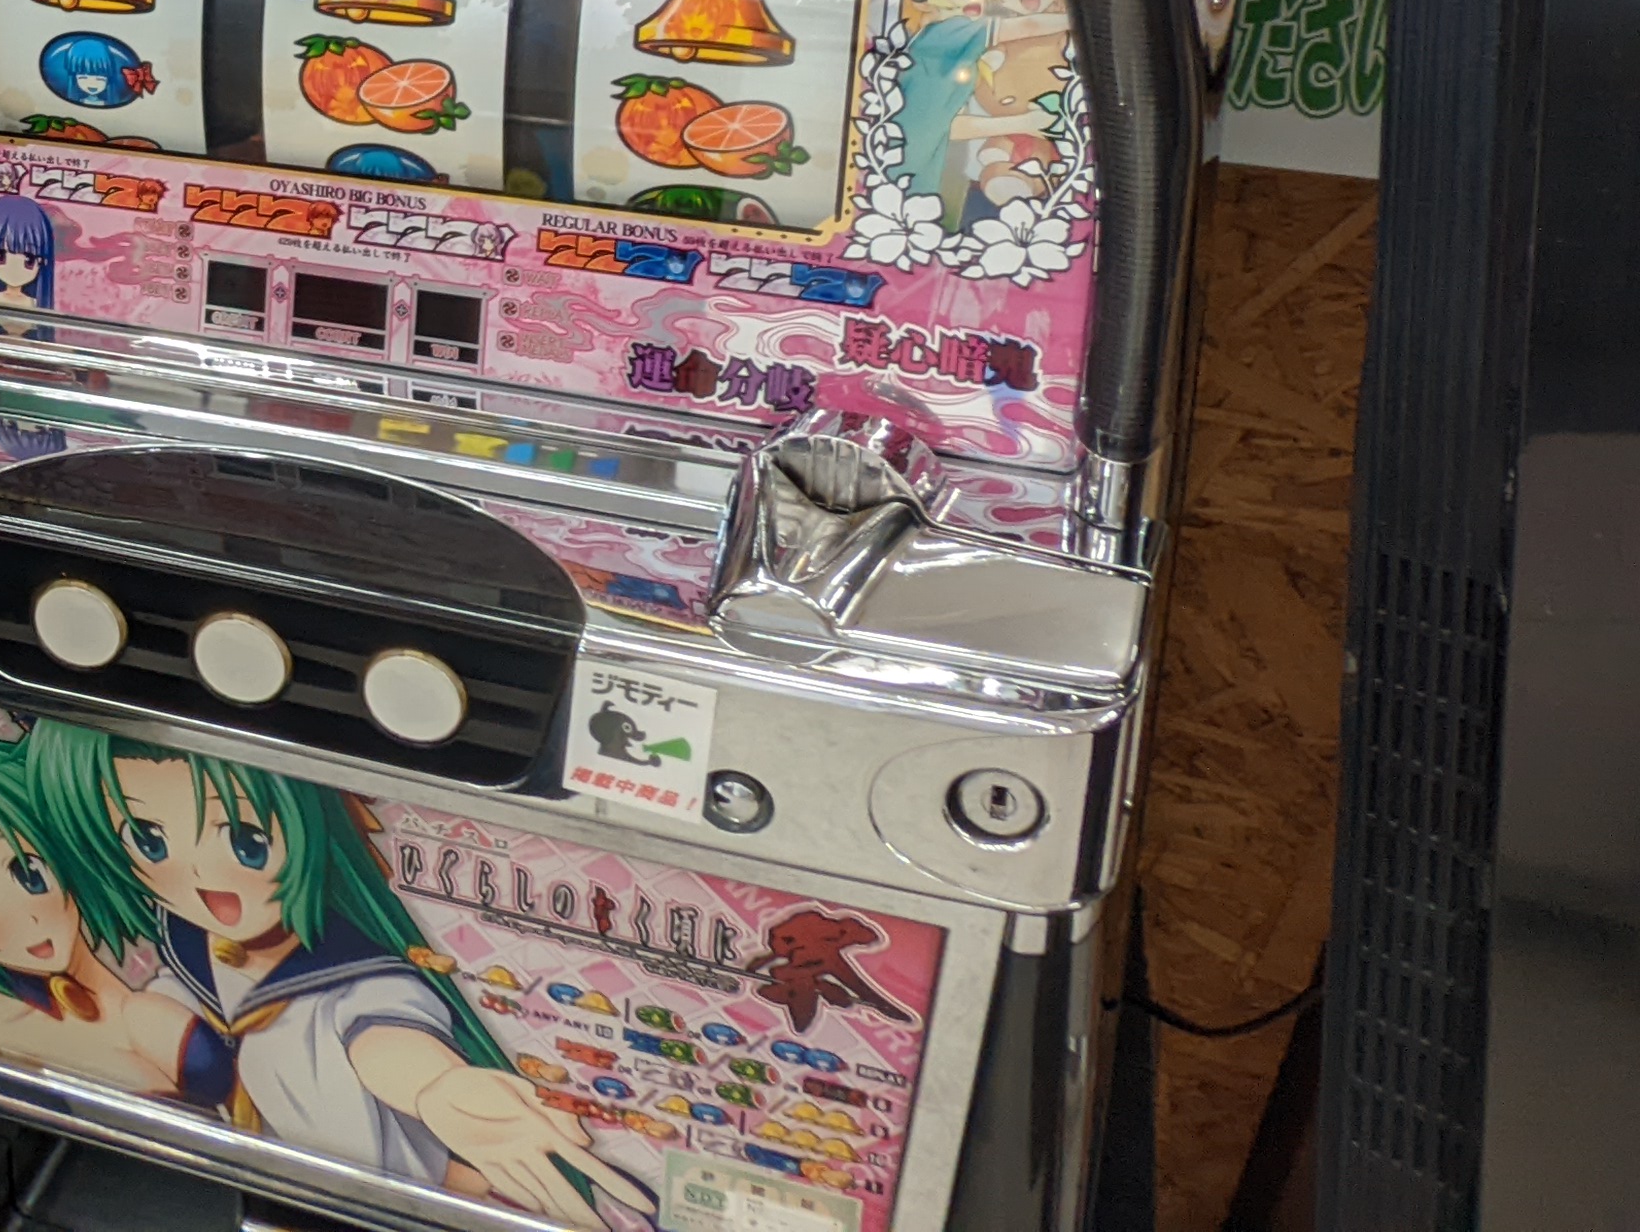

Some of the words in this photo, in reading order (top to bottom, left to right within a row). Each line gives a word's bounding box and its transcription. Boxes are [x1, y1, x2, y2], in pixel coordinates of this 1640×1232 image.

[270, 179, 345, 201] OYASHIRO
[349, 187, 372, 204] BIG
[376, 191, 427, 210] BONUS
[542, 213, 618, 236] REGULAR
[622, 221, 678, 243] BONUS
[591, 672, 698, 712] ジモティー
